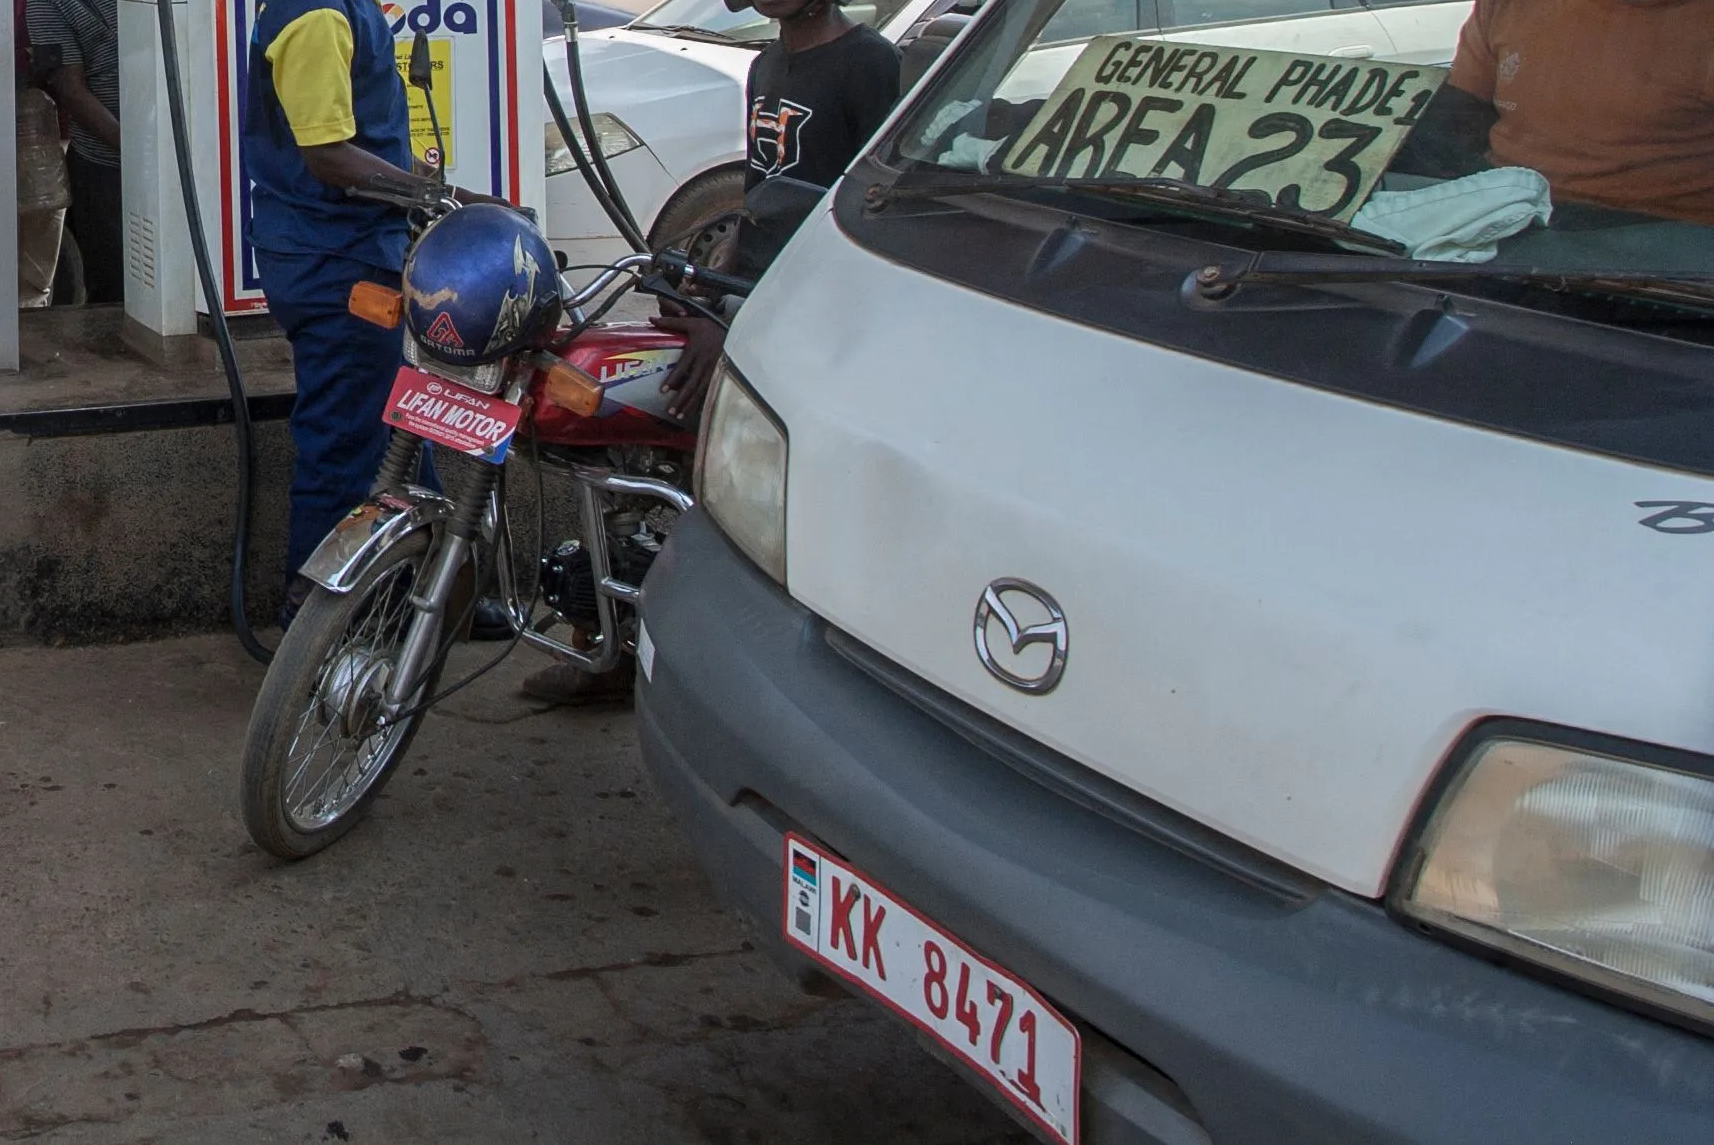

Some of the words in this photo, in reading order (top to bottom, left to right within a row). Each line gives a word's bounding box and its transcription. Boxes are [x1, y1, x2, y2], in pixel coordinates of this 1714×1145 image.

[1094, 41, 1258, 99] GENERAL
[1011, 87, 1216, 187] AREA
[1215, 112, 1383, 217] 23
[396, 389, 449, 421] LIFAN
[441, 405, 507, 442] MOTOR
[444, 388, 491, 410] LIFAN
[830, 875, 886, 982] KK
[924, 940, 1042, 1106] 8471
